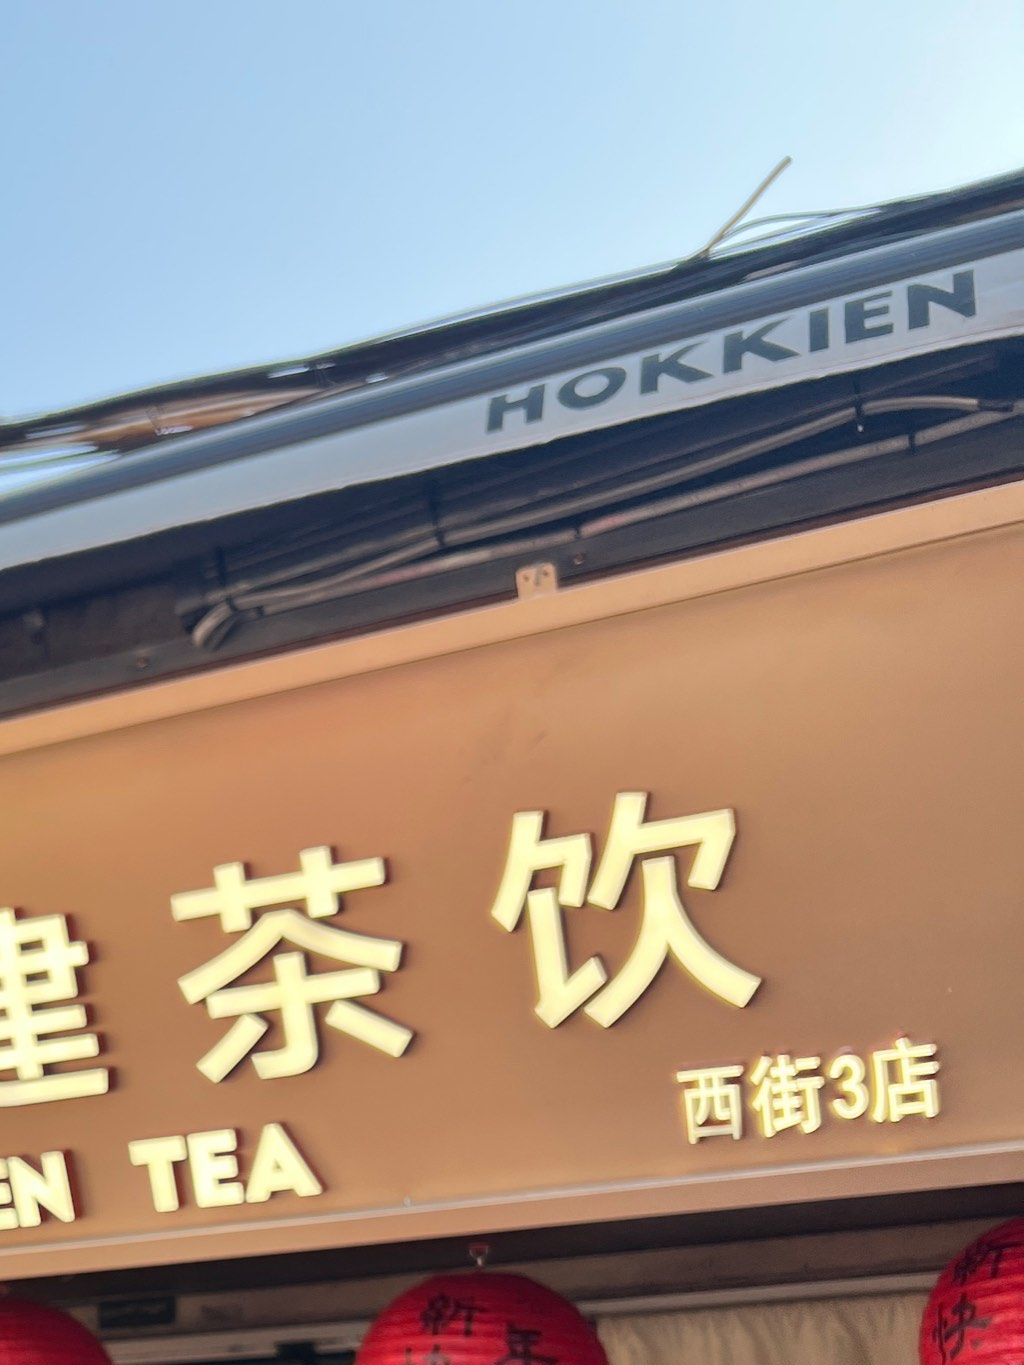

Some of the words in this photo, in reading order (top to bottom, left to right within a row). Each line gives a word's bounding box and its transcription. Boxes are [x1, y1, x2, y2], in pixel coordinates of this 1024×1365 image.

[487, 270, 978, 433] HOKKIEN
[676, 1036, 940, 1145] 西街3店
[129, 1122, 323, 1213] TEA
